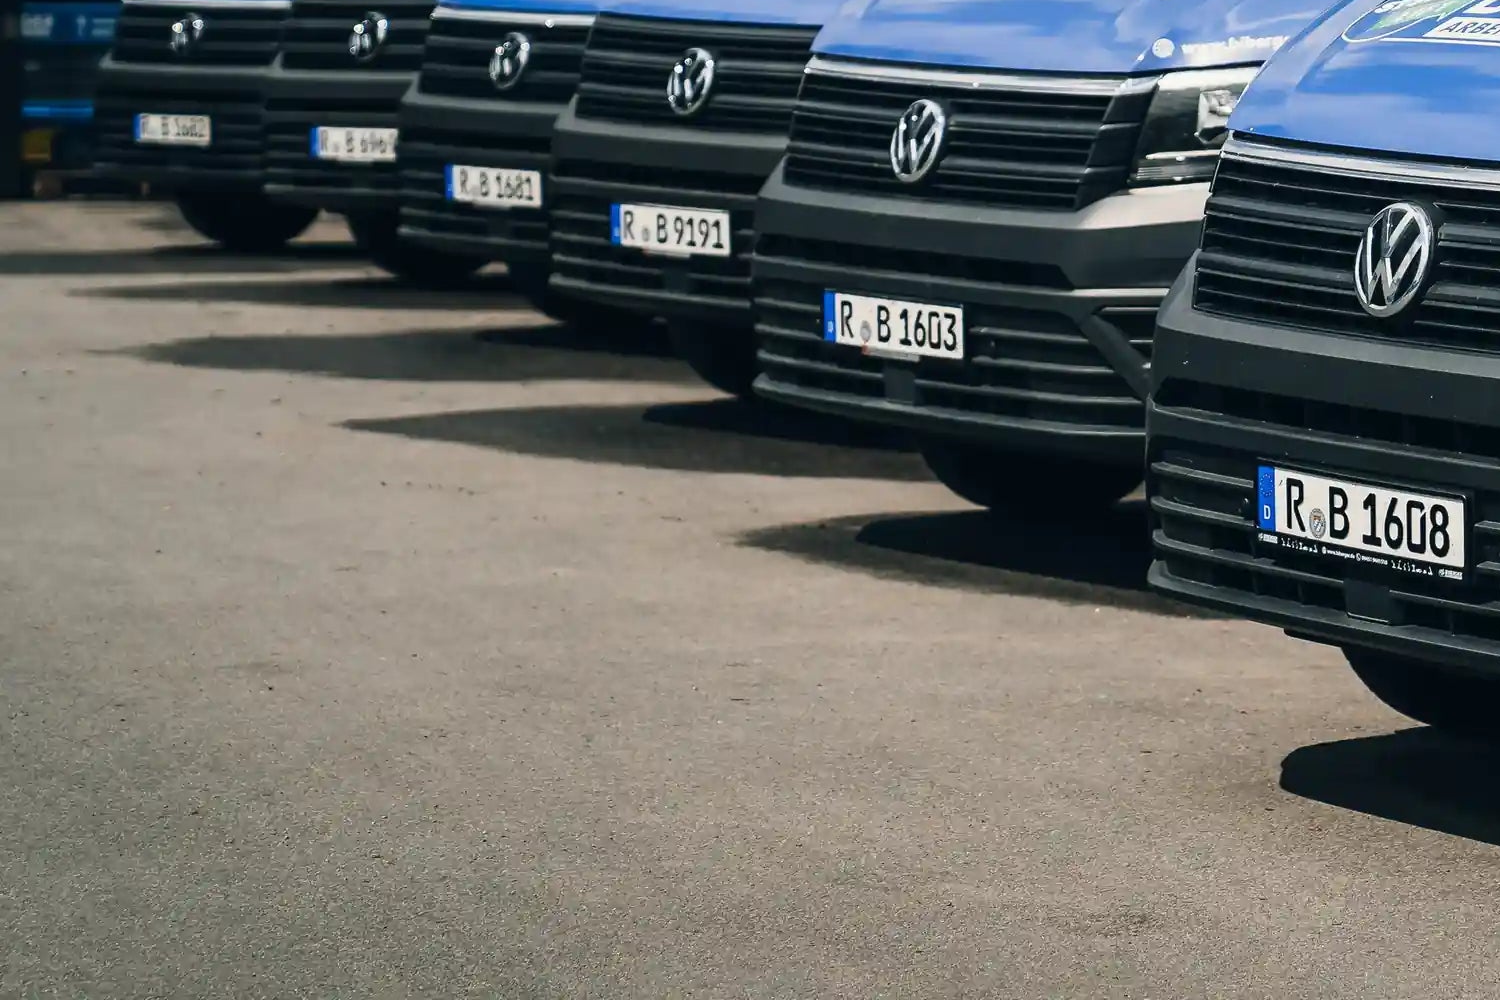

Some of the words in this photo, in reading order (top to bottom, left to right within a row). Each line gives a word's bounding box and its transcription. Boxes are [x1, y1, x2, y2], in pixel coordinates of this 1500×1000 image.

[623, 210, 635, 240] R
[656, 213, 668, 243] B
[673, 216, 724, 249] 9191
[840, 300, 854, 338] R
[877, 305, 891, 343] B
[899, 308, 957, 352] 1603
[1286, 477, 1306, 532] R
[1328, 485, 1350, 540] B
[1362, 492, 1450, 558] 1608
